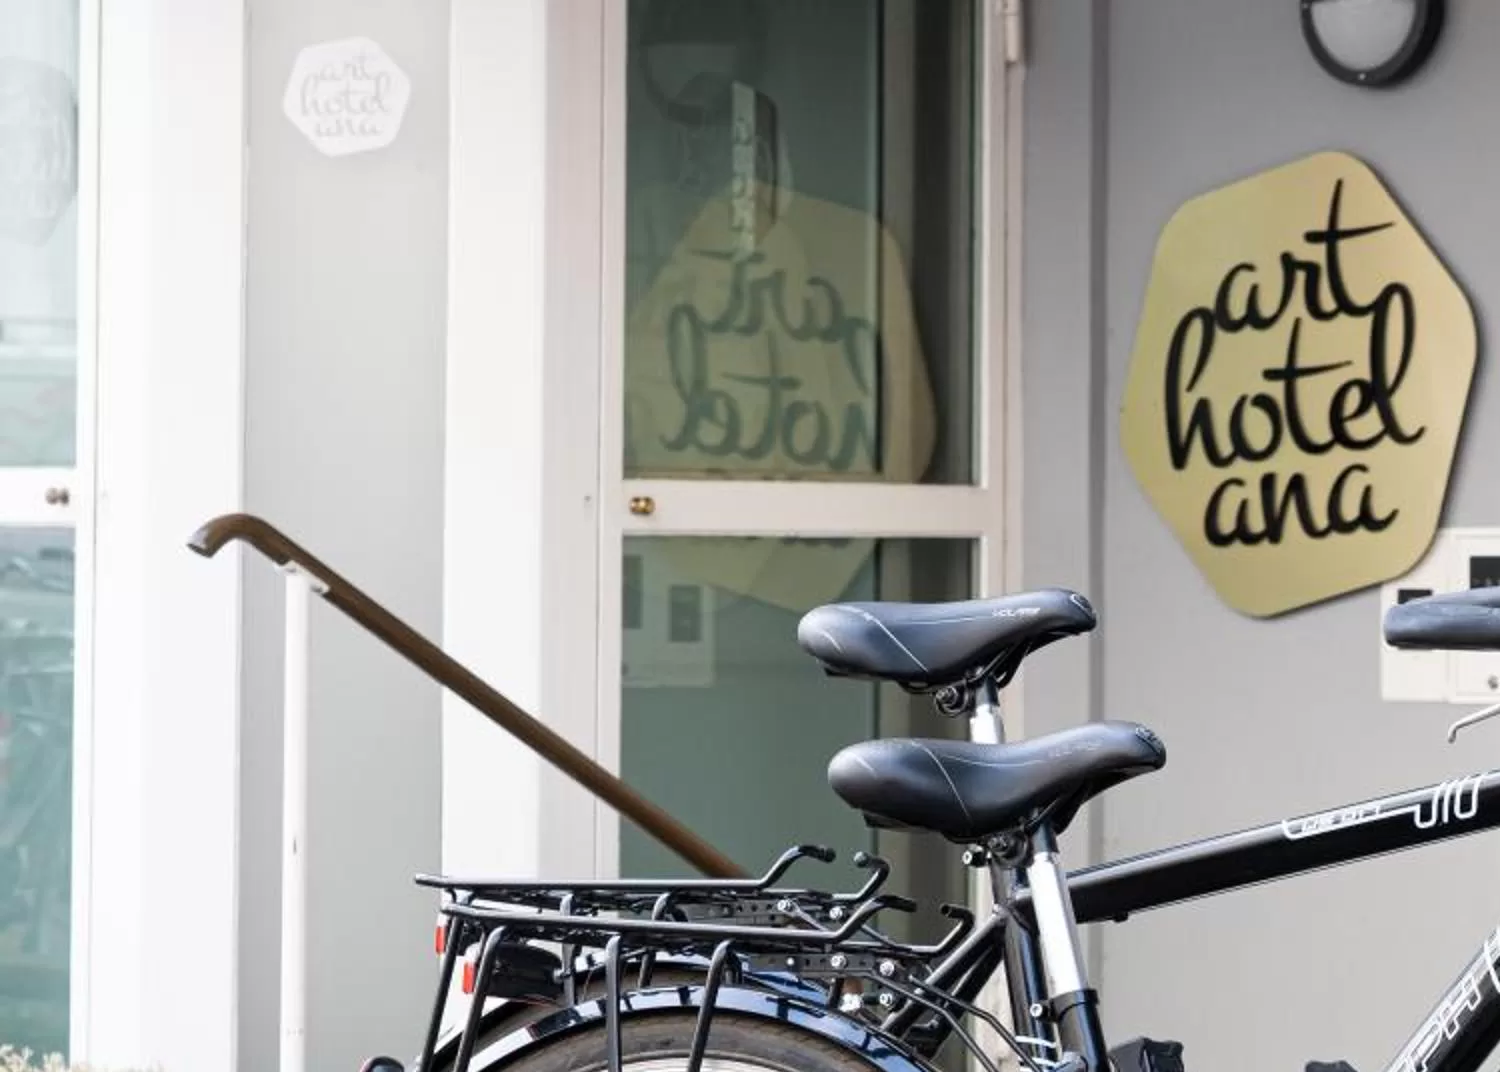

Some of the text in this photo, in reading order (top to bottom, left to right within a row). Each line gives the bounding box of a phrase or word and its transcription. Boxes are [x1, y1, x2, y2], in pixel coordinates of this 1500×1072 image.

[1215, 178, 1397, 333] art
[1165, 282, 1428, 470] hotel
[1204, 463, 1399, 548] ana
